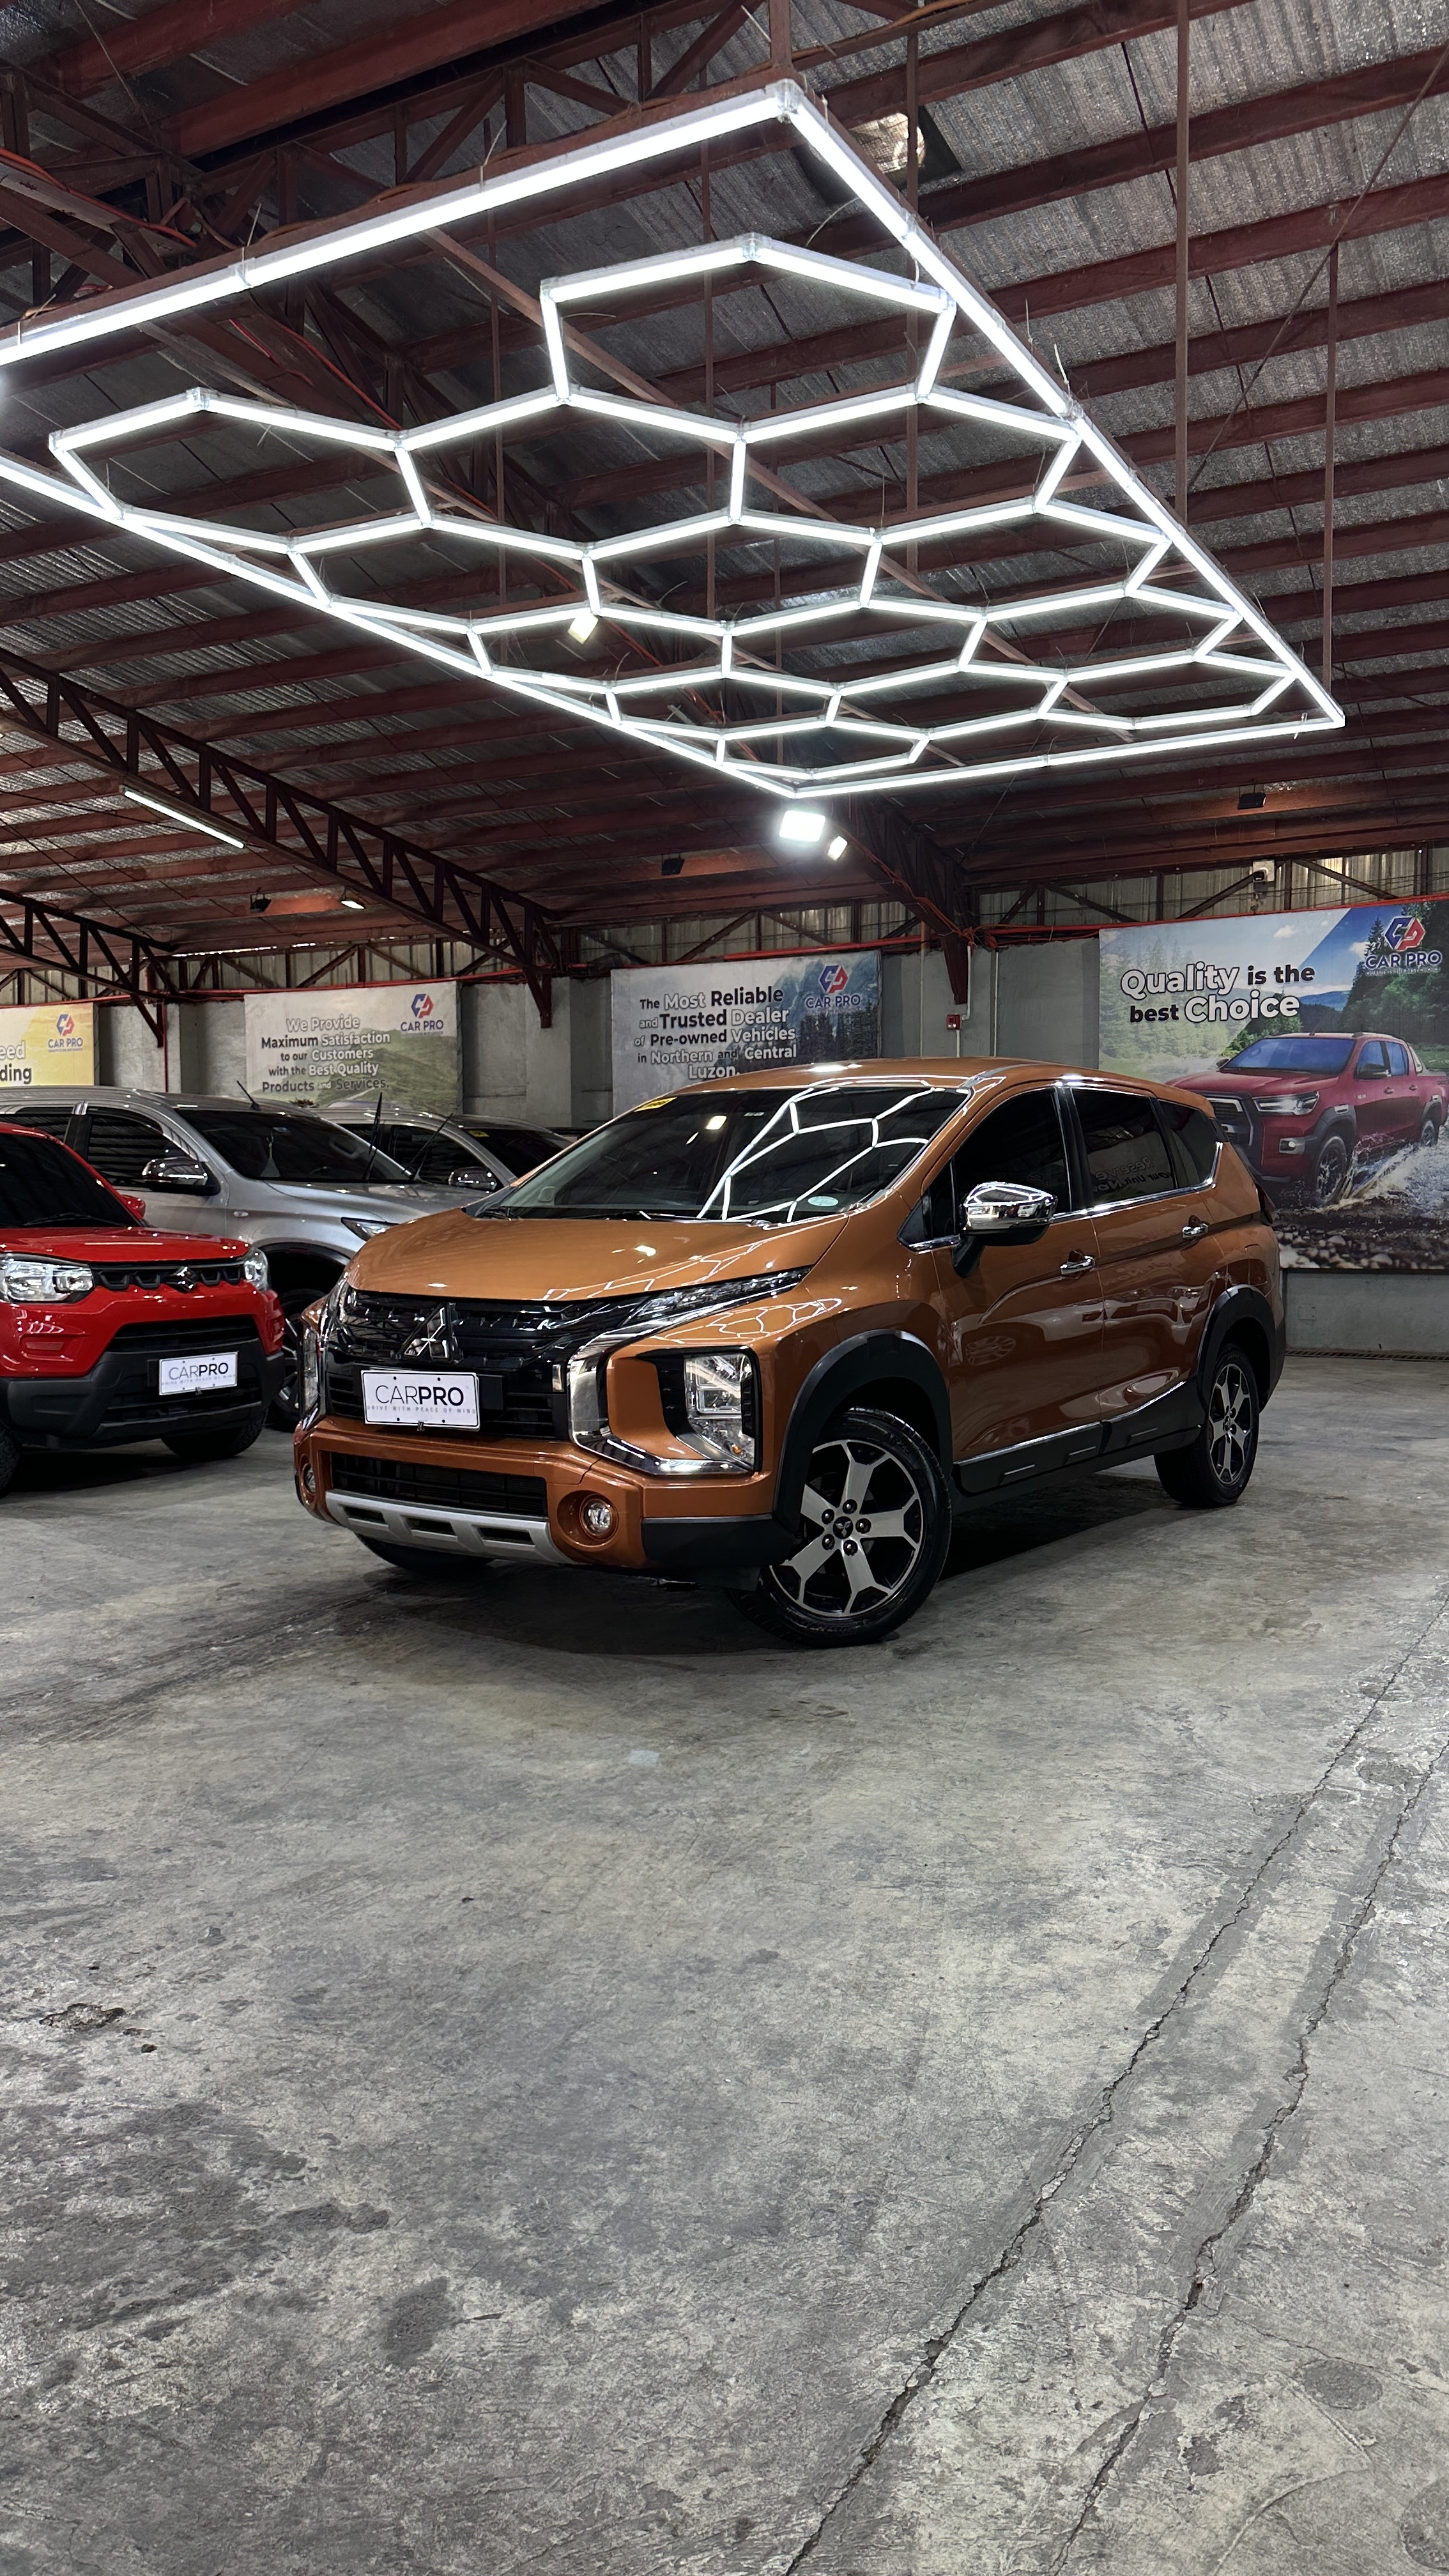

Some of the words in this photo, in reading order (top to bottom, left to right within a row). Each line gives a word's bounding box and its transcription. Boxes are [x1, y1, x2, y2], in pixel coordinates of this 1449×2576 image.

[1365, 953, 1402, 970] CAR
[1405, 949, 1443, 967] PRO
[1121, 962, 1240, 1000] Quality
[1247, 965, 1267, 986] is
[1274, 964, 1316, 984] the
[640, 999, 661, 1010] The
[663, 992, 706, 1010] Most
[710, 986, 785, 1007] Reliable
[806, 995, 831, 1009] CAR
[834, 993, 861, 1007] PRO
[1130, 1004, 1179, 1023] best
[1184, 990, 1301, 1023] Choice
[286, 1018, 307, 1032] We
[310, 1013, 361, 1031] Provide
[401, 1020, 421, 1032] CAR
[423, 1019, 444, 1030] PRO
[639, 1017, 658, 1029] and
[659, 1009, 728, 1029] Trusted
[730, 1007, 790, 1025] Dealer
[48, 1038, 65, 1048] CAR
[66, 1037, 84, 1047] PRO
[261, 1034, 319, 1049] Maximum
[321, 1031, 392, 1047] Satisfaction
[634, 1035, 645, 1046] of
[650, 1029, 728, 1046] Pre-owned
[730, 1026, 796, 1044] Vehicles
[280, 1053, 291, 1061] to
[293, 1052, 308, 1061] our
[311, 1048, 374, 1062] Customers
[638, 1052, 647, 1063] in
[650, 1047, 714, 1065] Northern
[717, 1048, 738, 1060] and
[744, 1044, 797, 1061] Central
[268, 1066, 289, 1077] with
[291, 1066, 306, 1076] the
[309, 1063, 334, 1076] Best
[337, 1062, 379, 1077] Quality
[688, 1064, 741, 1079] Luzon.
[262, 1080, 315, 1093] Products
[318, 1082, 332, 1090] and
[336, 1078, 390, 1091] Services.
[169, 1361, 229, 1381] CARPRO
[375, 1384, 464, 1406] CARPRO
